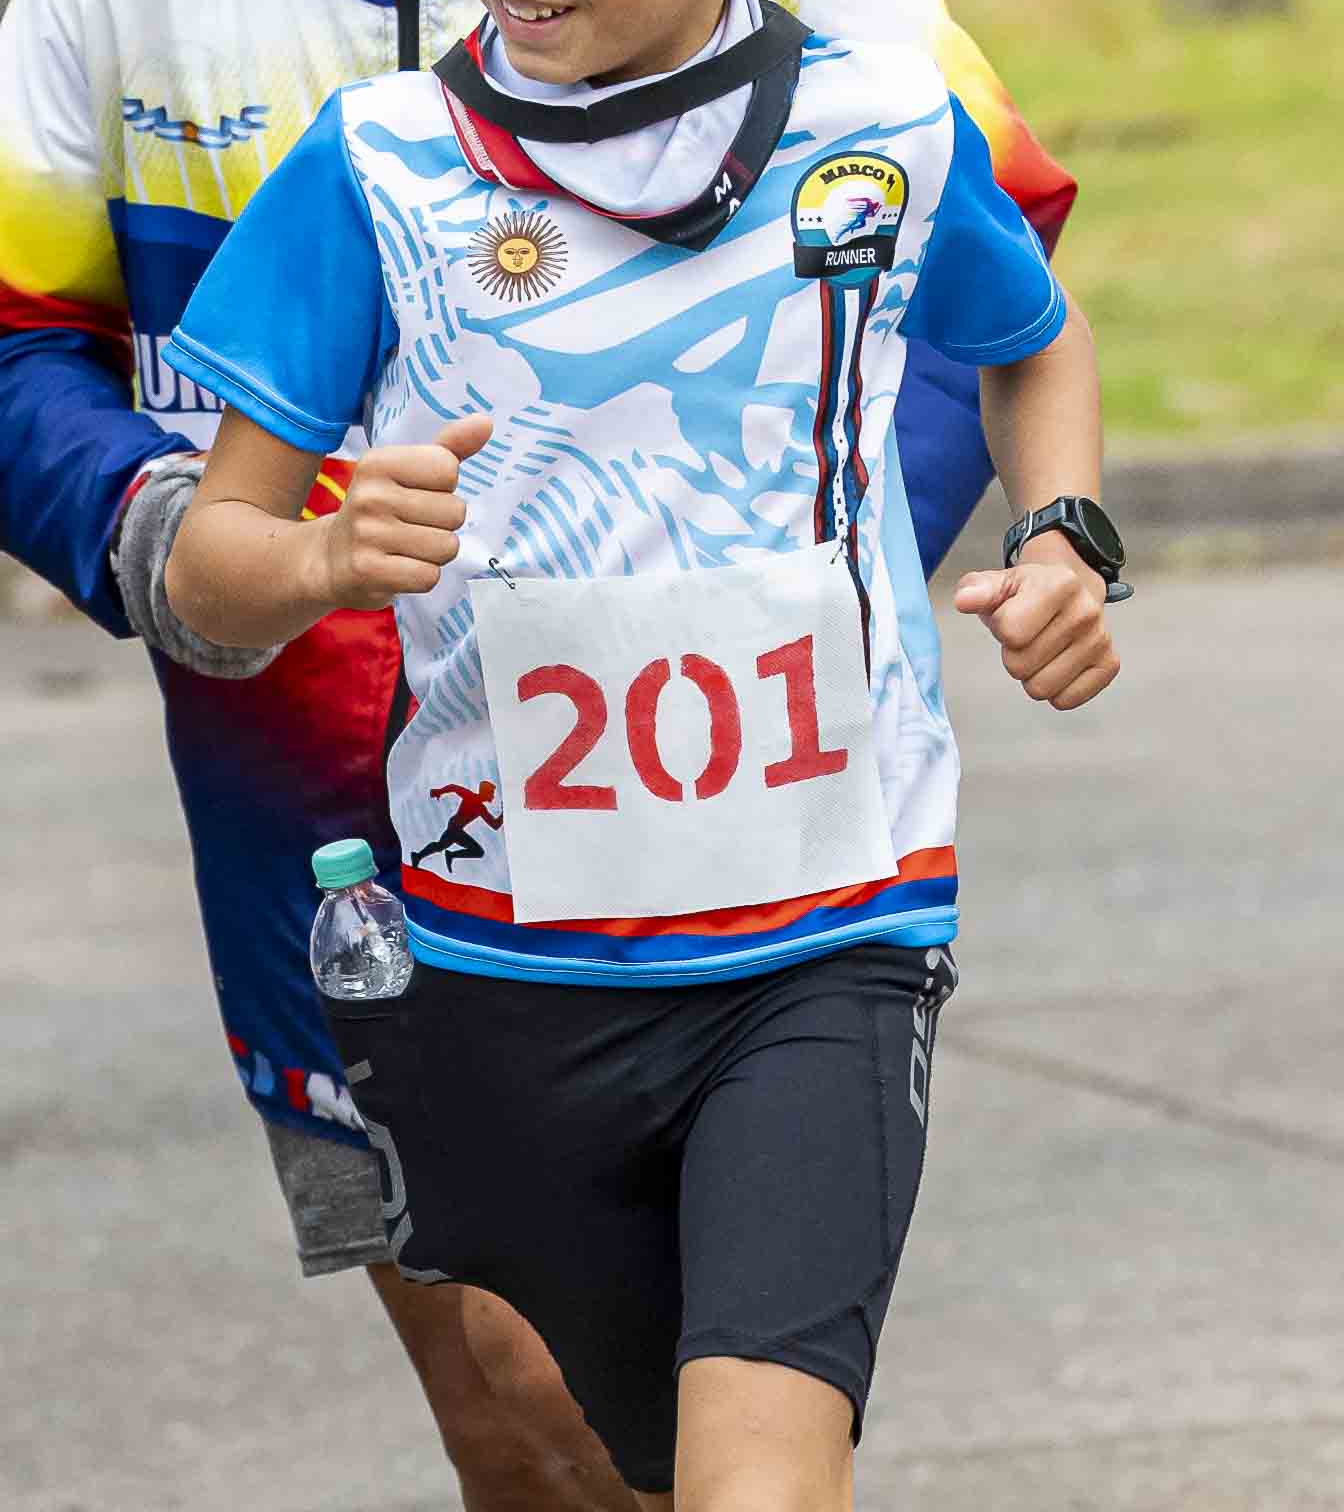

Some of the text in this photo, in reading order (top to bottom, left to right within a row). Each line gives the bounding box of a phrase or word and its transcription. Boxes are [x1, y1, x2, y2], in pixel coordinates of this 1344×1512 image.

[819, 163, 886, 186] MARCO
[824, 247, 876, 267] RUNNER
[517, 633, 849, 811] 201
